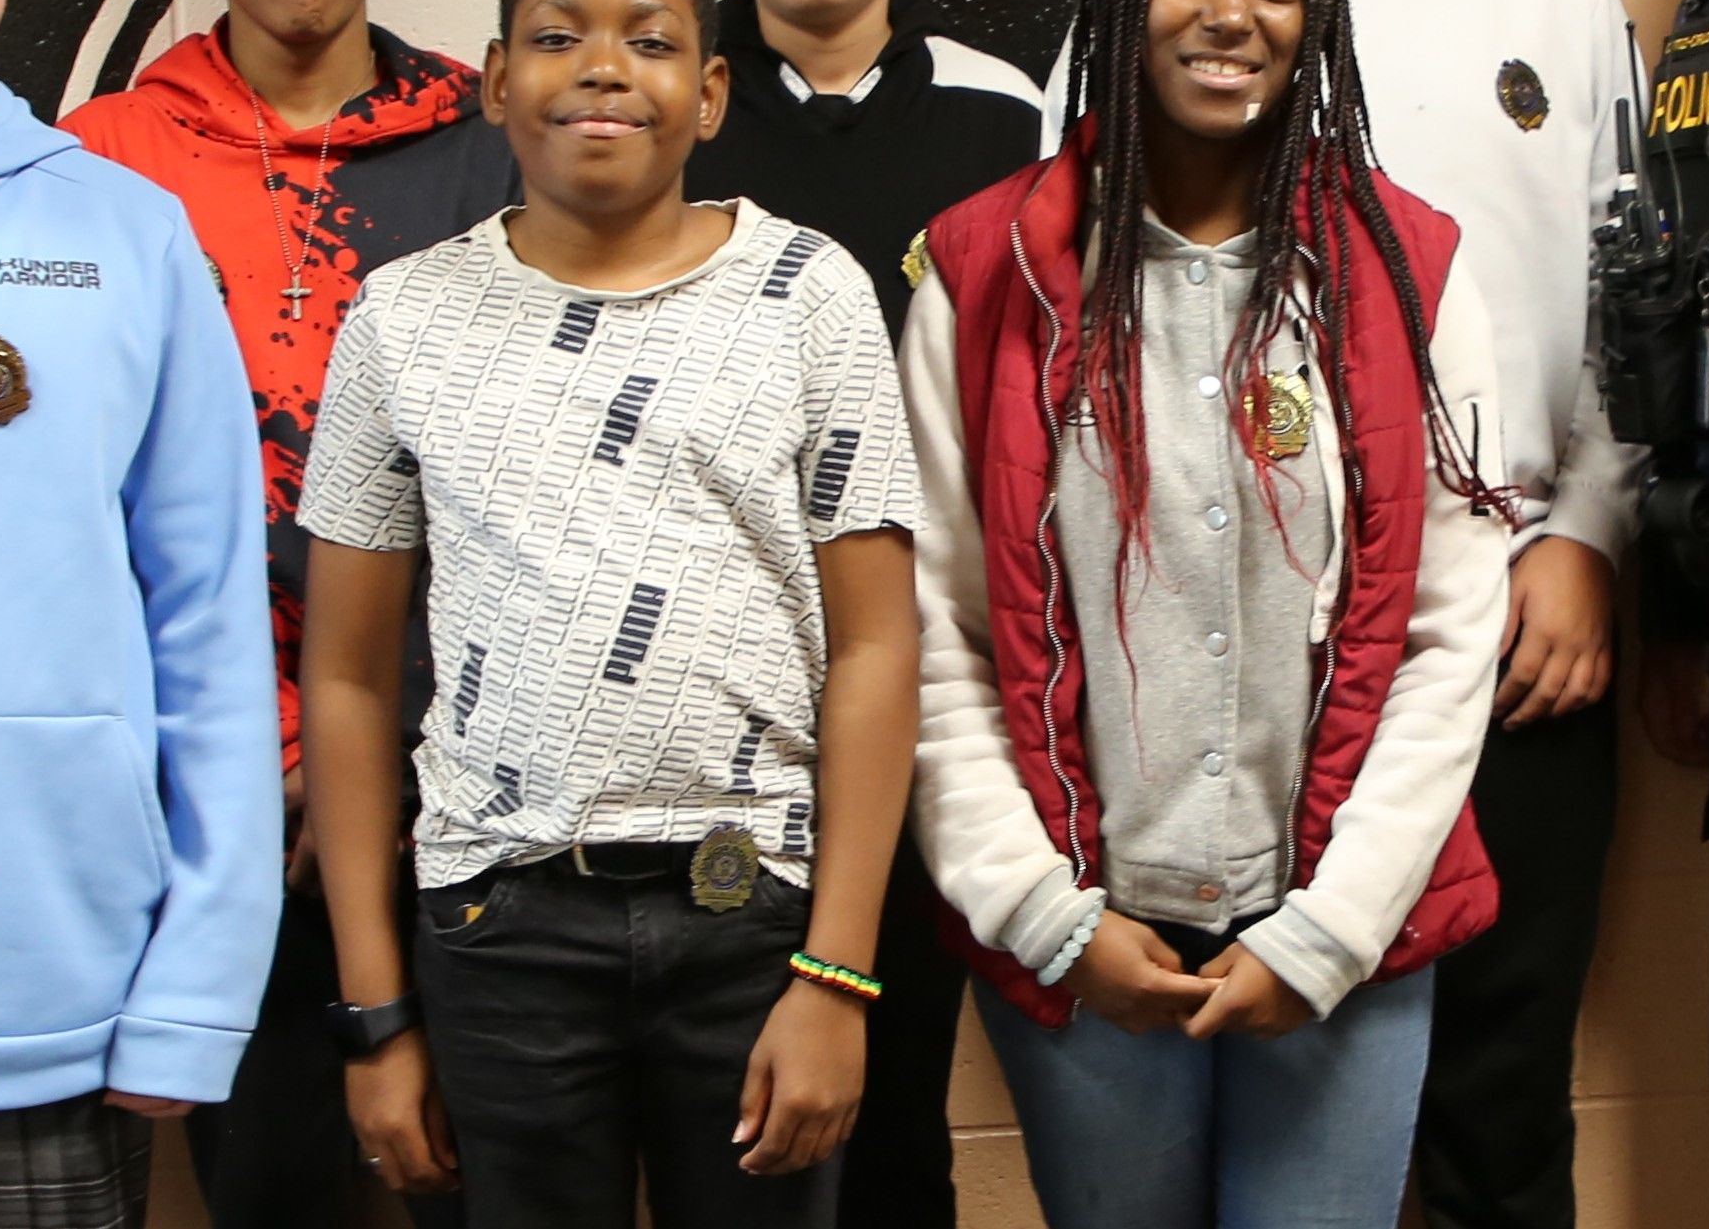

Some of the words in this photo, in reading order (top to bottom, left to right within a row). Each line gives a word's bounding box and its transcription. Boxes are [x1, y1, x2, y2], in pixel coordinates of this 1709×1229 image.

[20, 258, 99, 274] UNDER
[593, 374, 659, 467] PUMA
[602, 583, 668, 685] PUMA
